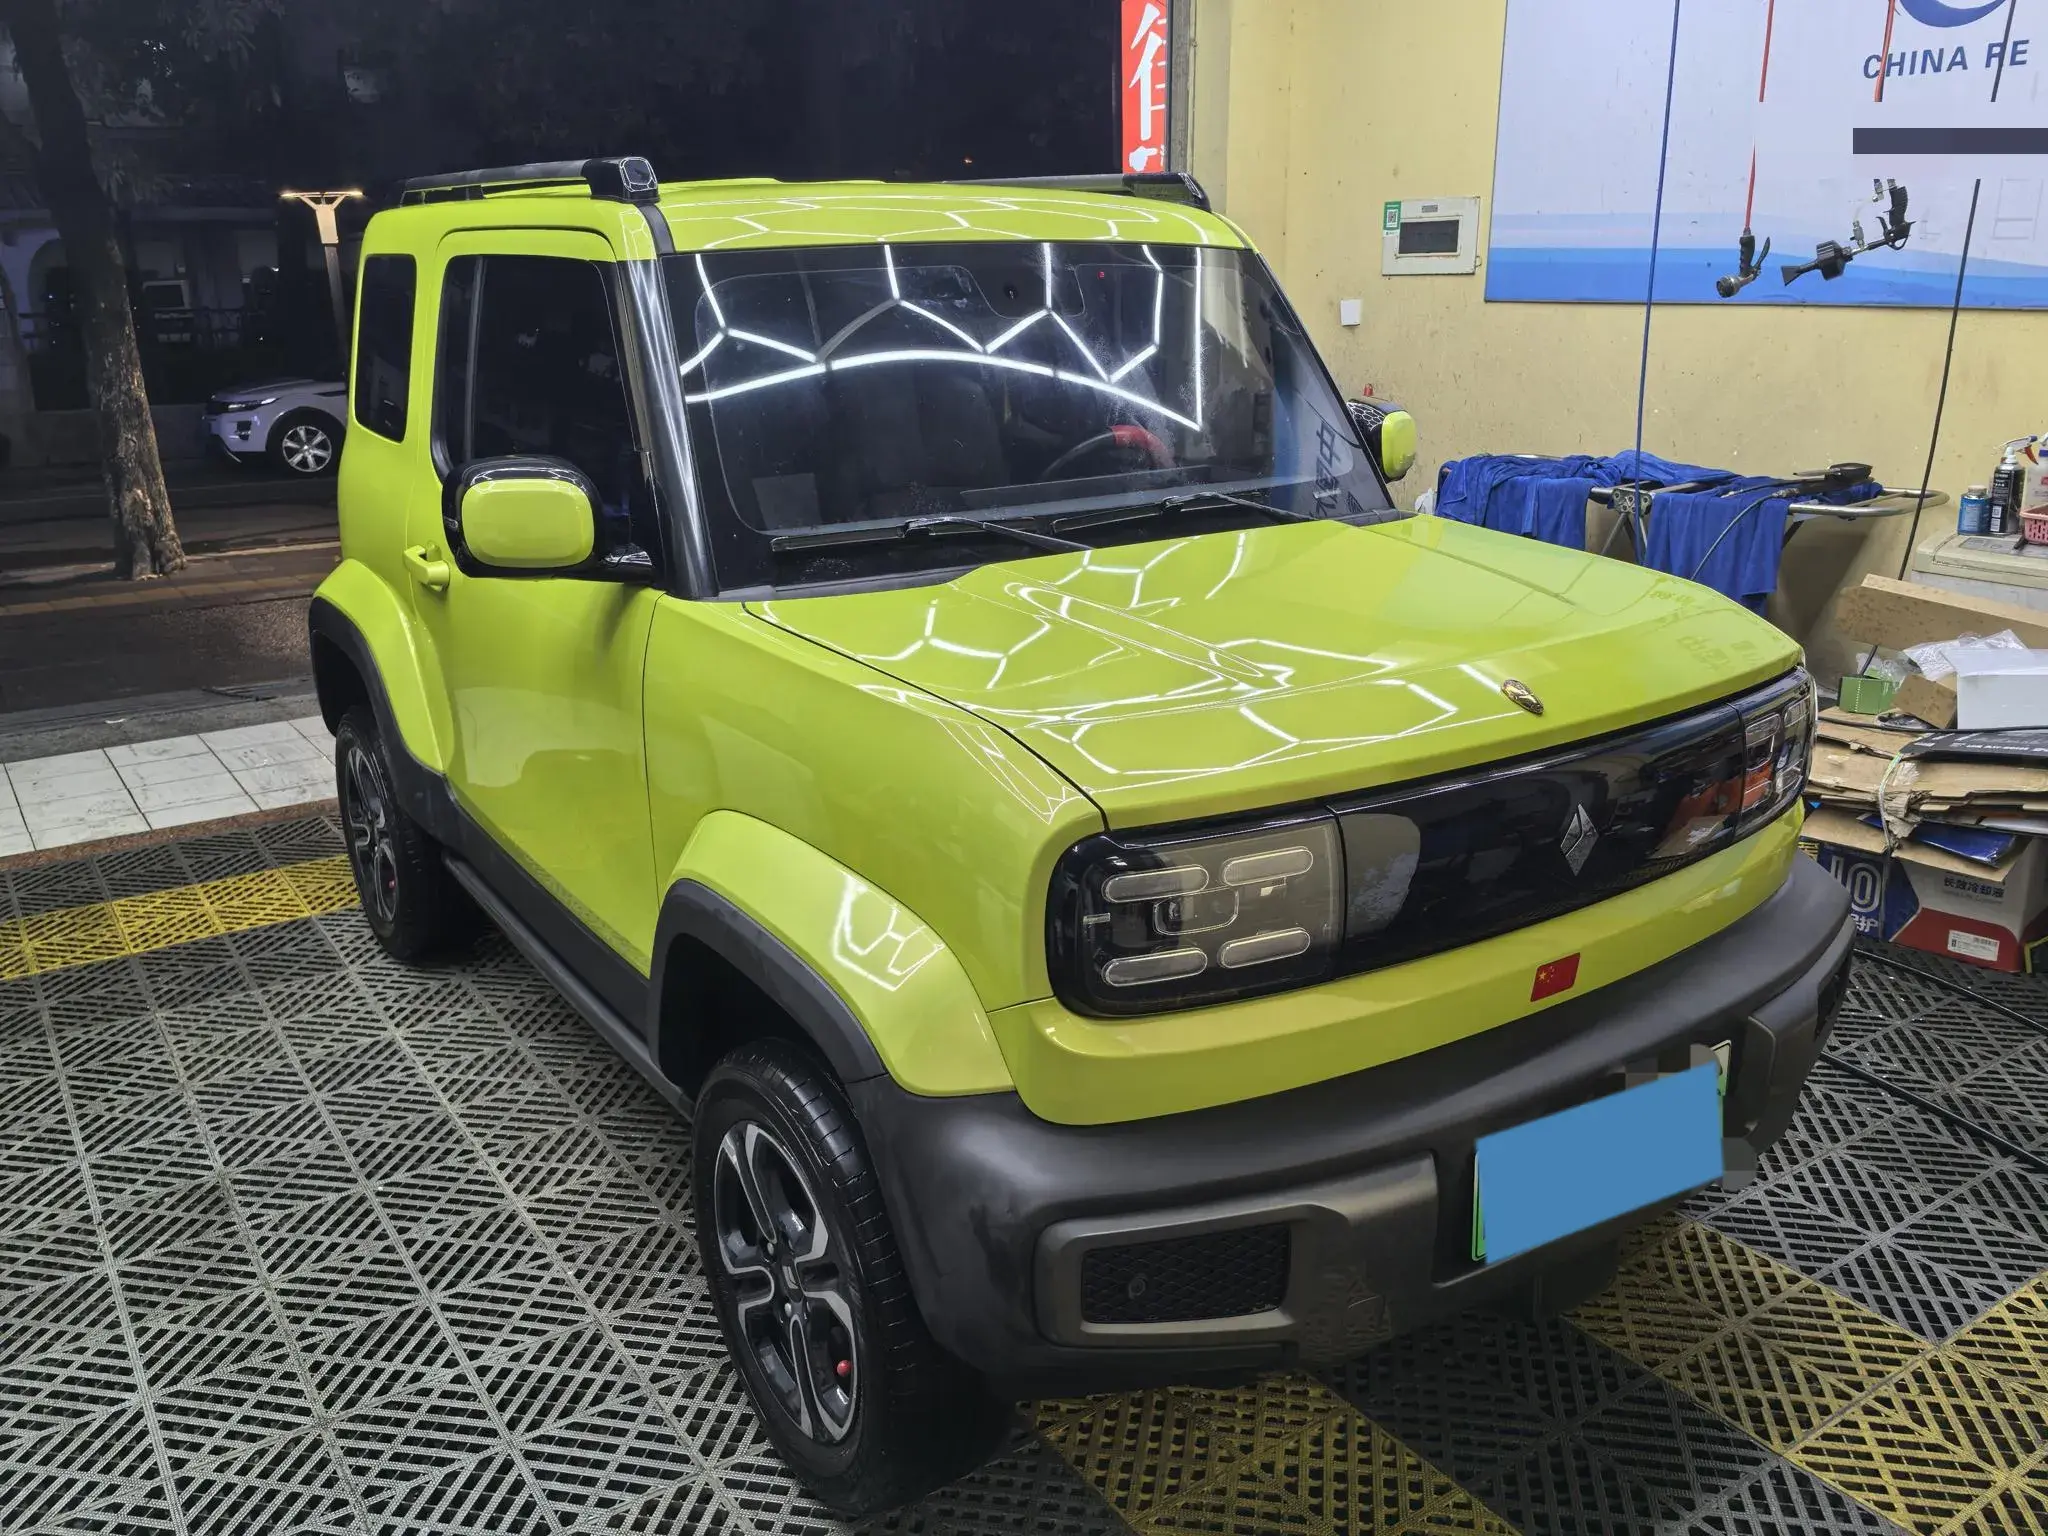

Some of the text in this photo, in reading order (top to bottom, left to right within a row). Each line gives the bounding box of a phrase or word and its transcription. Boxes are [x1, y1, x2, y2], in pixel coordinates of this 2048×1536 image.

[1863, 46, 1968, 79] CHINA
[1943, 876, 2005, 898] 长效冷却液
